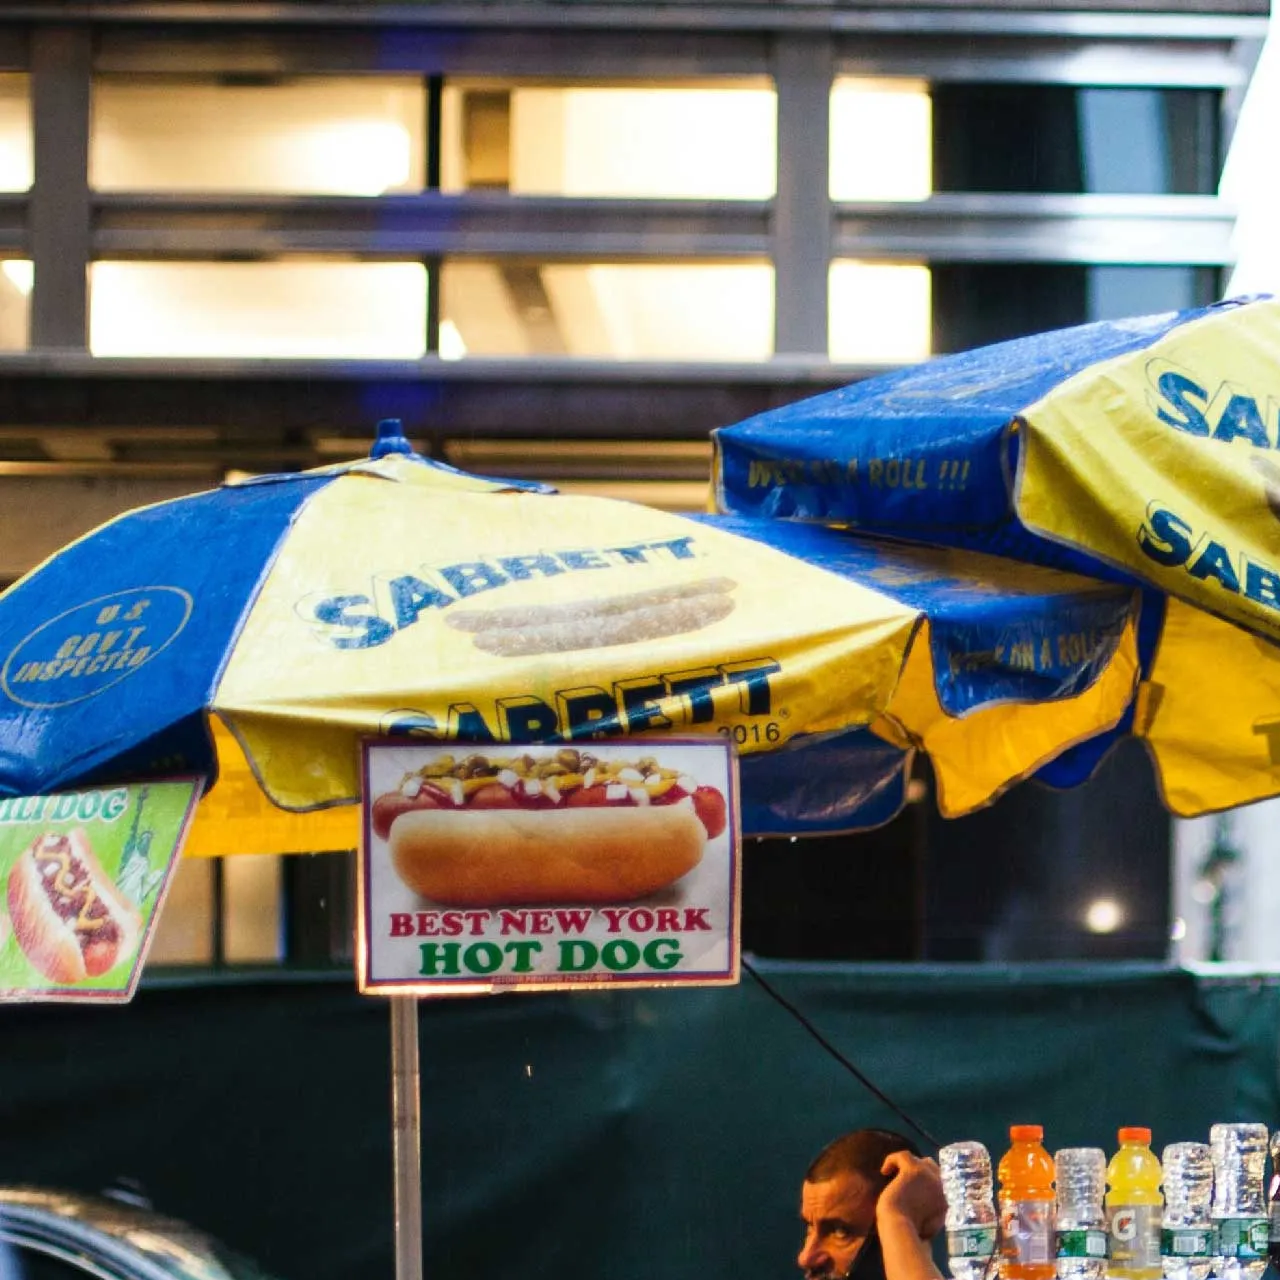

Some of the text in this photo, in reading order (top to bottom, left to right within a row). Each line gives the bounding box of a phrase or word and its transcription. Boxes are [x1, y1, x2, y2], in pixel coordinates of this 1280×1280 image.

[868, 459, 927, 489] ROLL
[938, 460, 971, 490] !!!
[297, 536, 698, 650] SABRETT
[51, 789, 128, 820] DOG
[388, 907, 712, 937] BEST NEW YORK
[418, 938, 684, 975] HOT DOG
